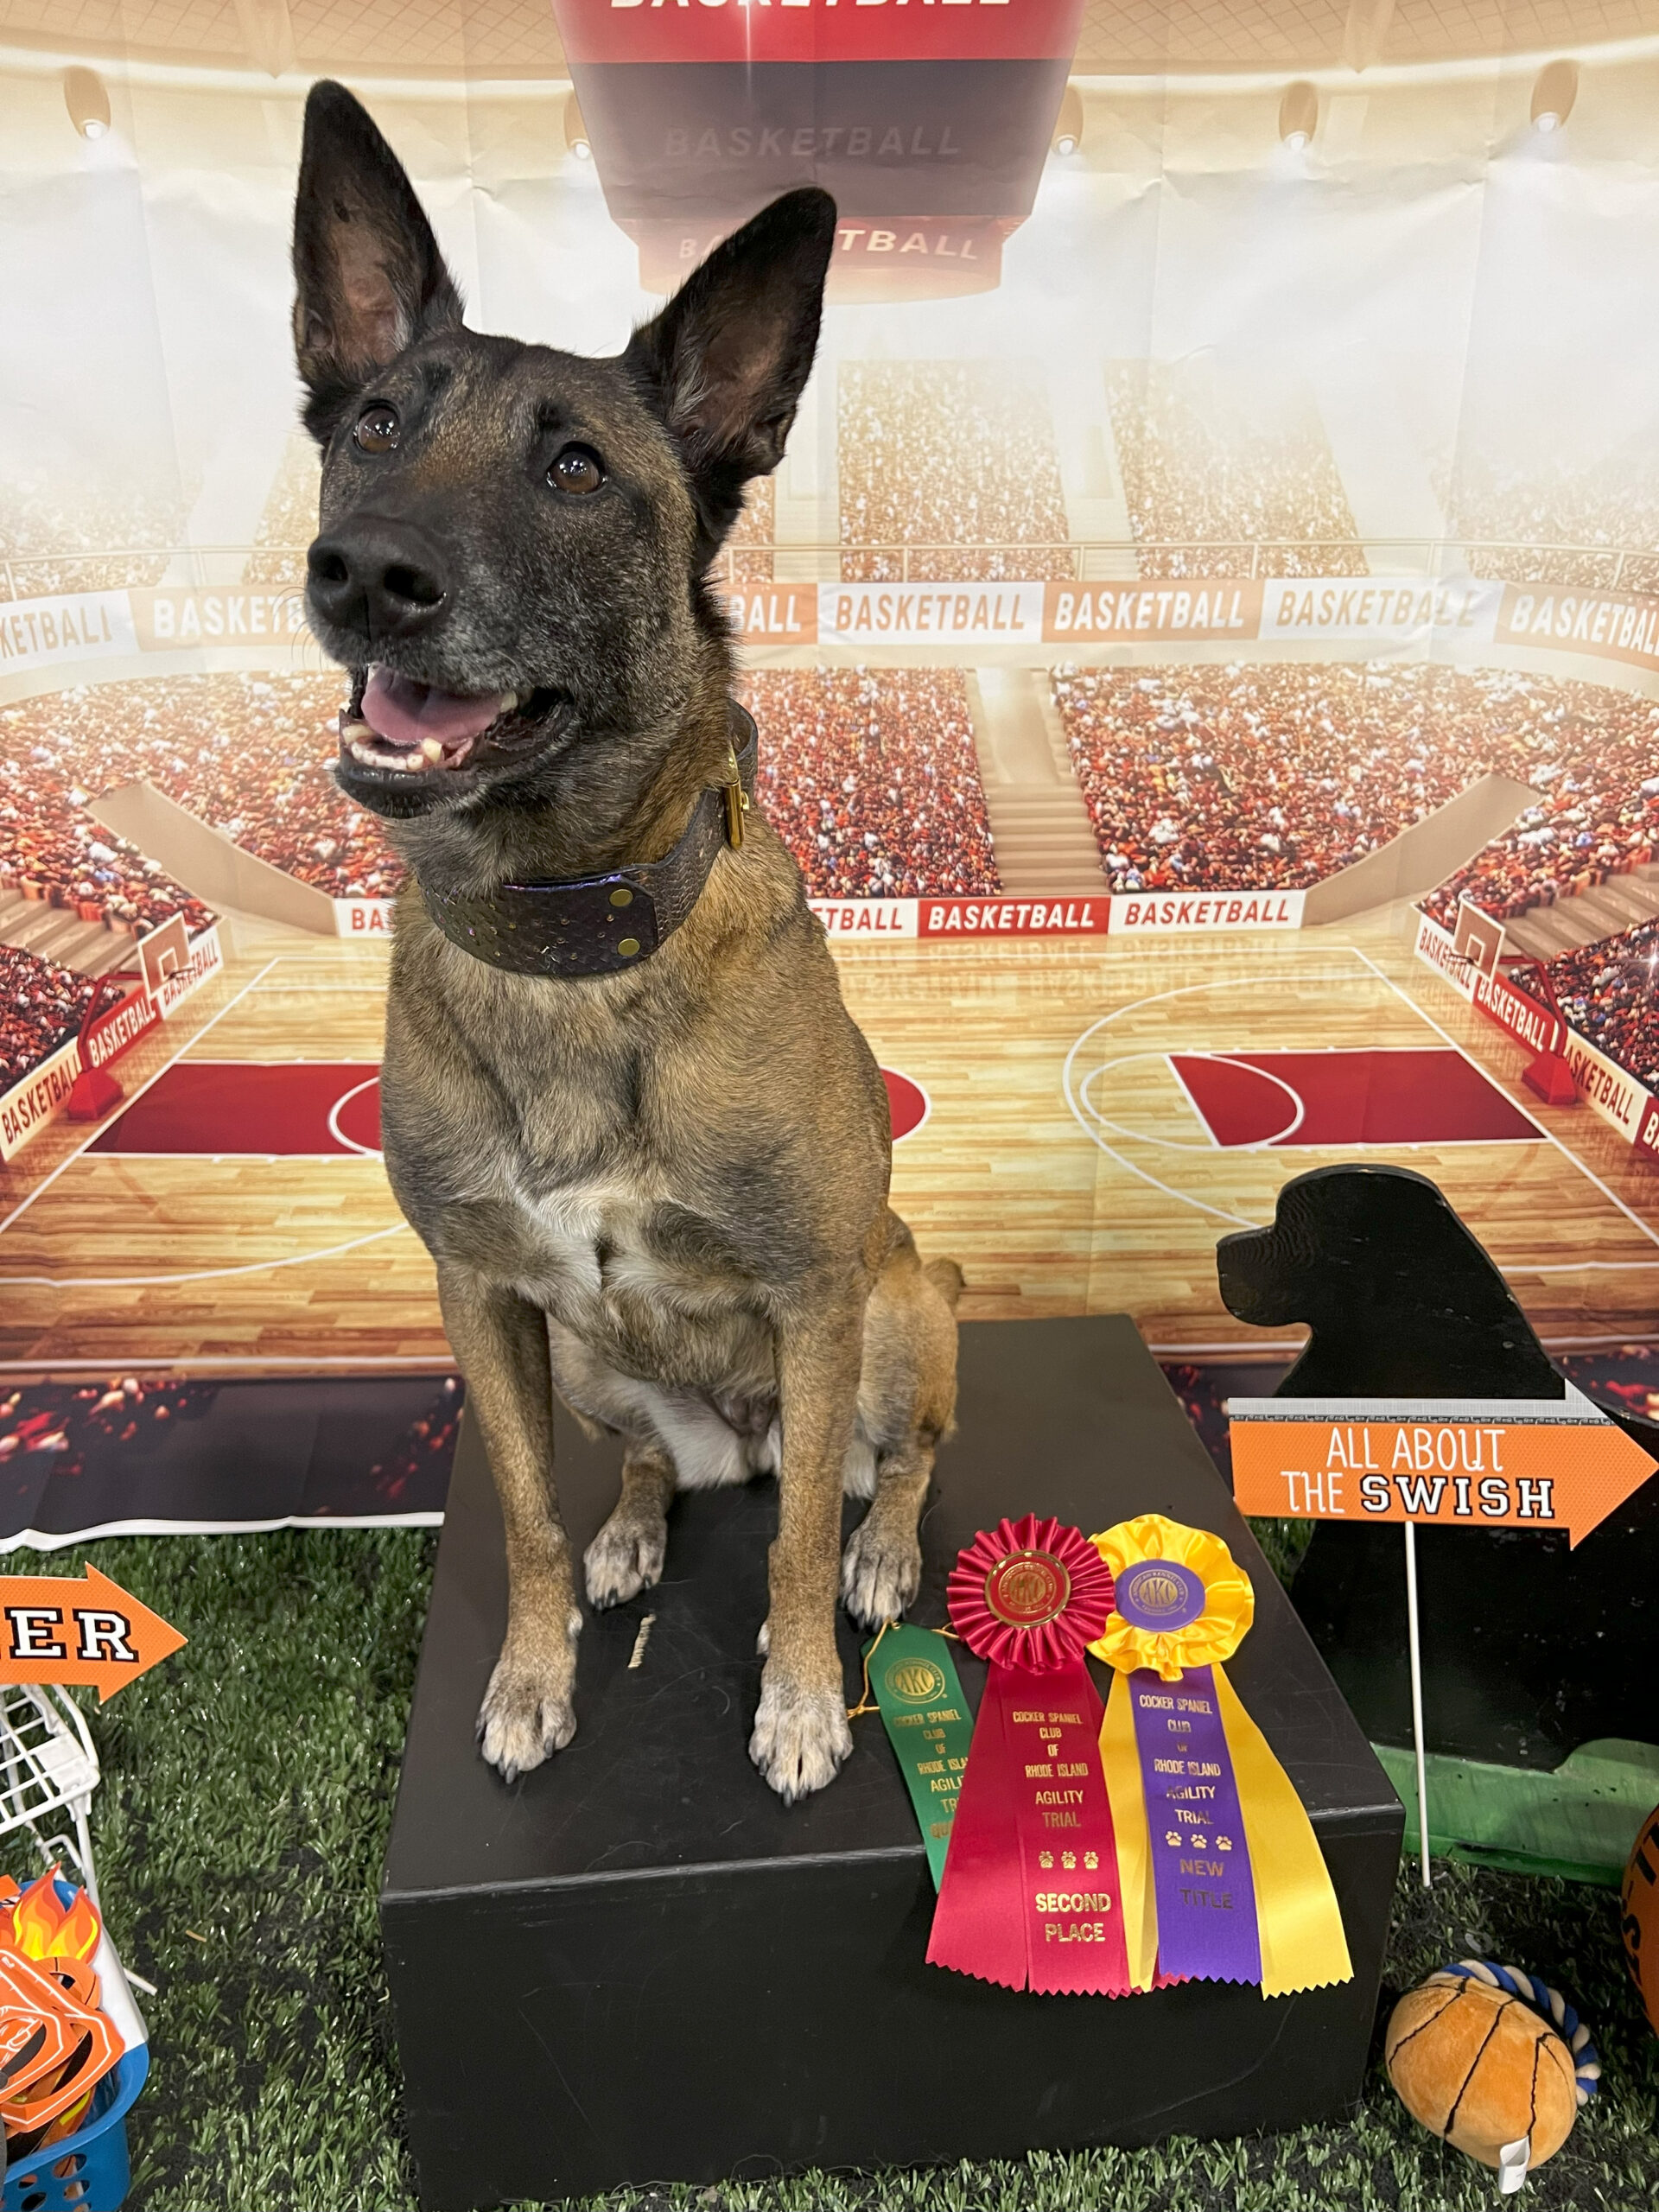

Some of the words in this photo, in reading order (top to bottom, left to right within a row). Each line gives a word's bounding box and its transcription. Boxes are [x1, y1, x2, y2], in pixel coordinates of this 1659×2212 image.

[664, 126, 962, 157] BASKETBALL
[835, 594, 1025, 632] BASKETBALL
[1053, 590, 1245, 631] BASKETBALL
[1275, 588, 1475, 627] BASKETBALL
[927, 901, 1096, 931] BASKETBALL
[1124, 899, 1291, 925] BASKETBALL
[1477, 976, 1546, 1053] BASKETBALL
[89, 996, 156, 1068] BASKETBALL
[1326, 1427, 1380, 1469] ALL
[1392, 1427, 1506, 1471] ABOUT
[1281, 1471, 1345, 1514] THE
[1360, 1474, 1556, 1520] SWISH
[1139, 1578, 1179, 1607] AKC
[0, 1607, 140, 1663] ER
[894, 1666, 936, 1696] AKC
[1139, 1694, 1174, 1710] COCKER
[1176, 1698, 1213, 1714] SPANIEL
[893, 1713, 925, 1727] COCKER
[927, 1709, 962, 1724] SPANIEL
[1012, 1711, 1046, 1723] COCKER
[1048, 1713, 1084, 1725] SPANIEL
[1167, 1719, 1192, 1733] CLUB
[923, 1728, 946, 1739] CLUB
[1039, 1727, 1063, 1739] CLUB
[935, 1743, 946, 1754] OF
[1046, 1744, 1059, 1758] OF
[917, 1759, 948, 1775] RHODE
[1024, 1764, 1054, 1778] RHODE
[1057, 1763, 1090, 1777] ISLAND
[1154, 1758, 1185, 1775] RHODE
[1187, 1761, 1222, 1777] ISLAND
[1035, 1790, 1084, 1805] AGILITY
[1166, 1785, 1216, 1801] AGILITY
[1042, 1811, 1082, 1828] TRIAL
[1174, 1808, 1215, 1826] TRIAL
[1179, 1859, 1224, 1877] NEW
[1035, 1892, 1112, 1913] SECOND
[1179, 1888, 1234, 1910] TITLE
[1044, 1923, 1106, 1942] PLACE
